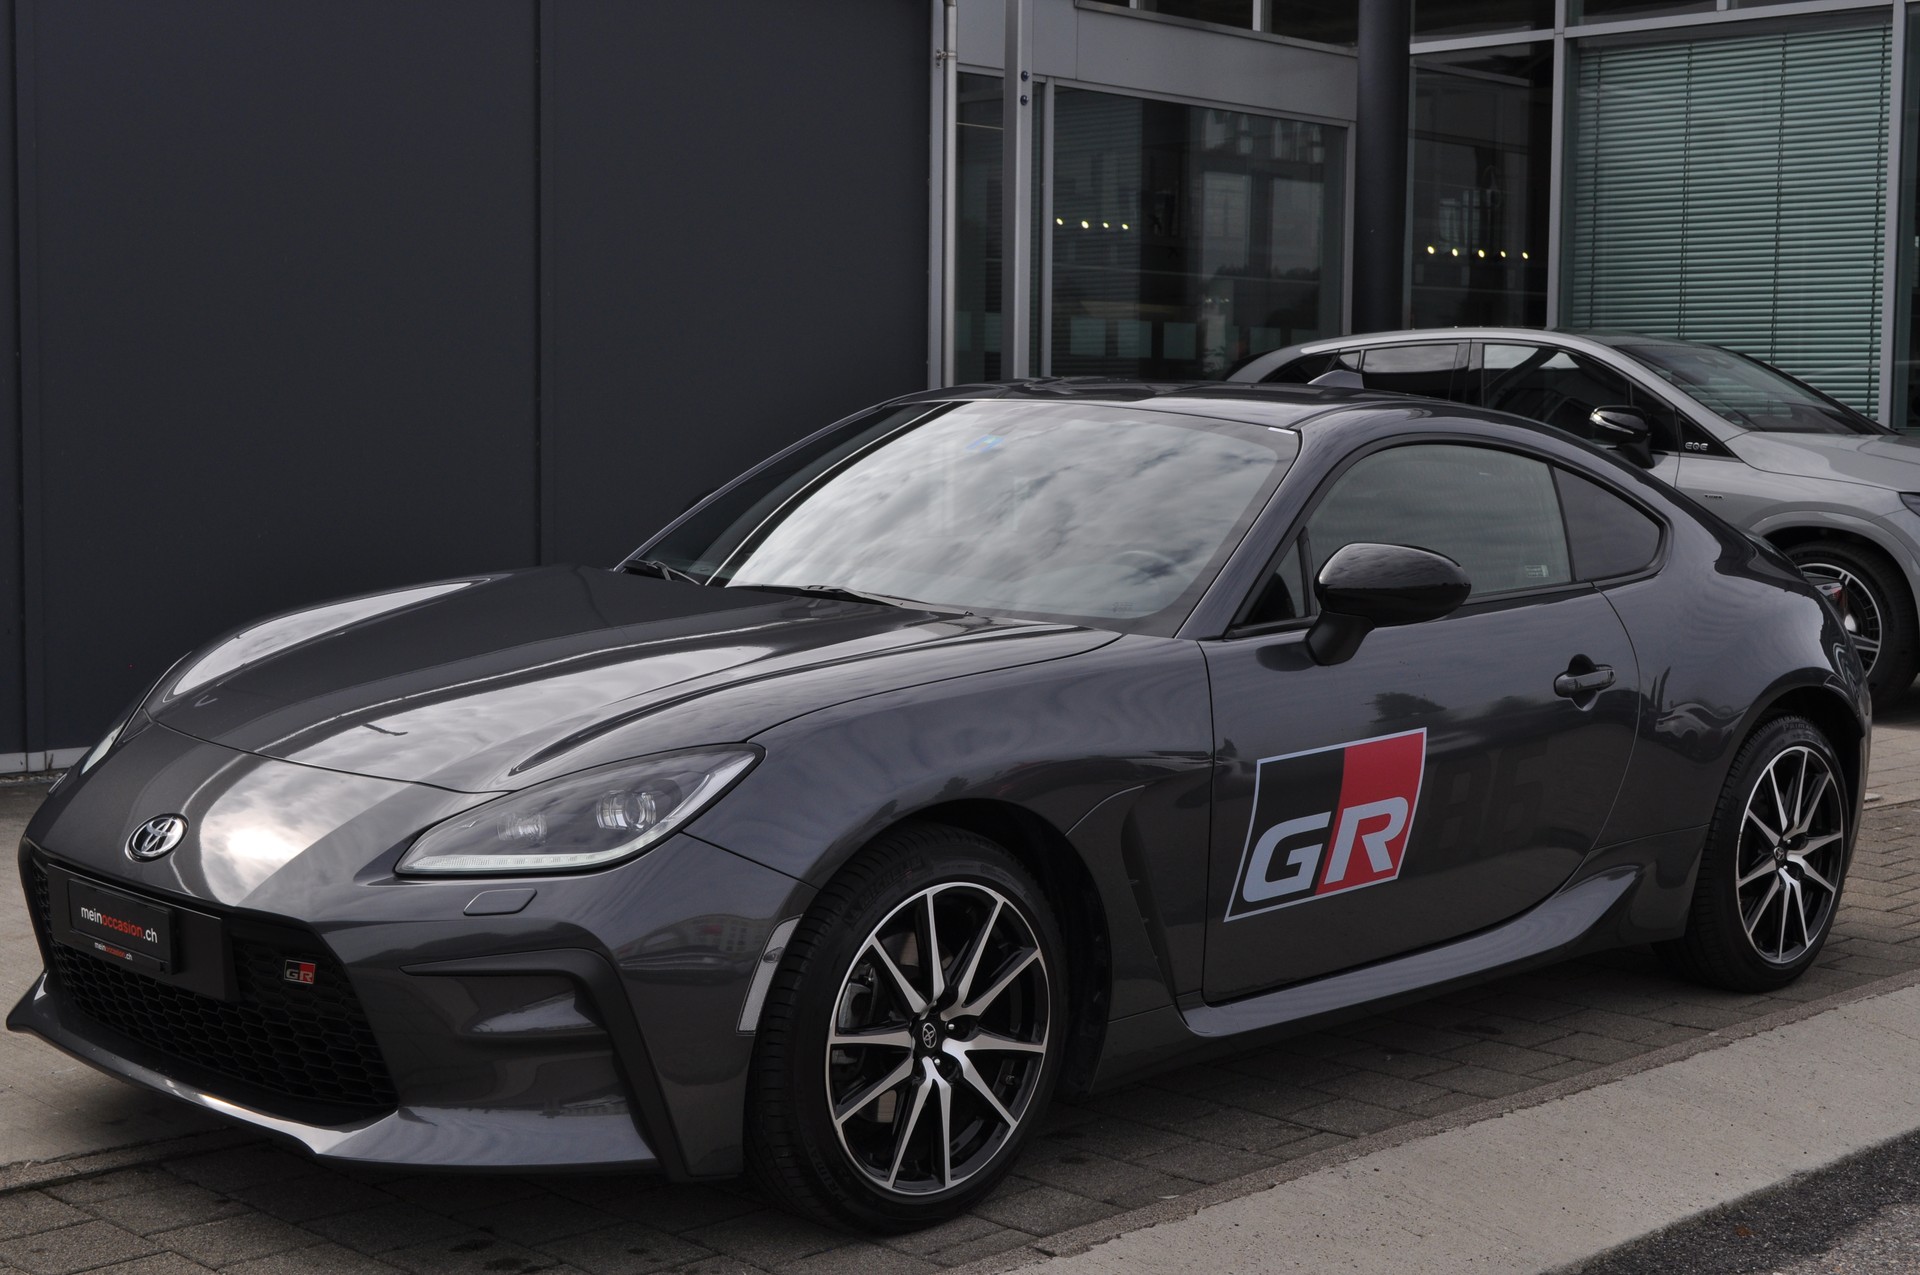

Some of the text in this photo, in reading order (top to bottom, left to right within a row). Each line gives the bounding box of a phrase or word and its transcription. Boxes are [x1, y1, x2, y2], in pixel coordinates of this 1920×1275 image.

[1242, 796, 1408, 902] GR
[80, 906, 158, 944] meinoccasion.ch
[285, 968, 313, 982] GR
